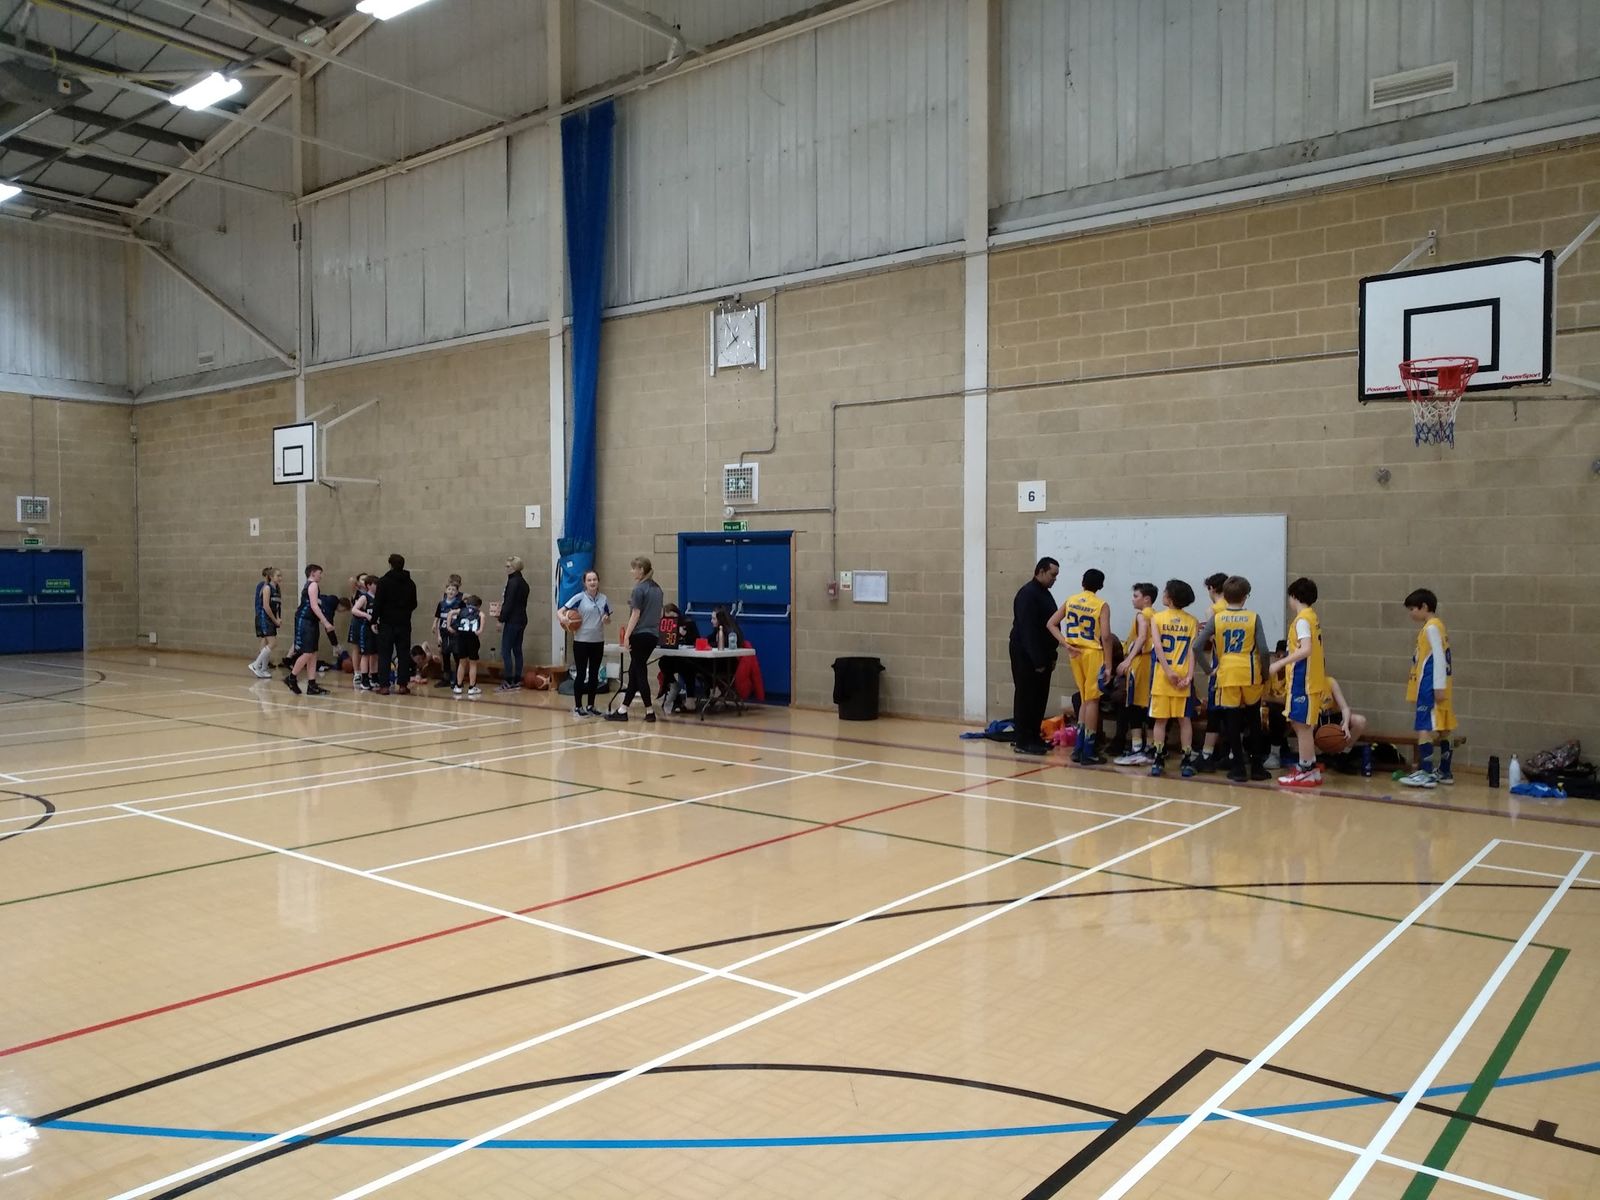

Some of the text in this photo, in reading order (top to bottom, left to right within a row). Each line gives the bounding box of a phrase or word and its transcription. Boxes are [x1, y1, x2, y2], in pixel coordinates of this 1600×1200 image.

[1501, 372, 1541, 380] PowerSport
[1028, 490, 1036, 502] 6
[530, 512, 535, 520] 7
[1066, 611, 1096, 641] 23
[1157, 634, 1191, 665] 27
